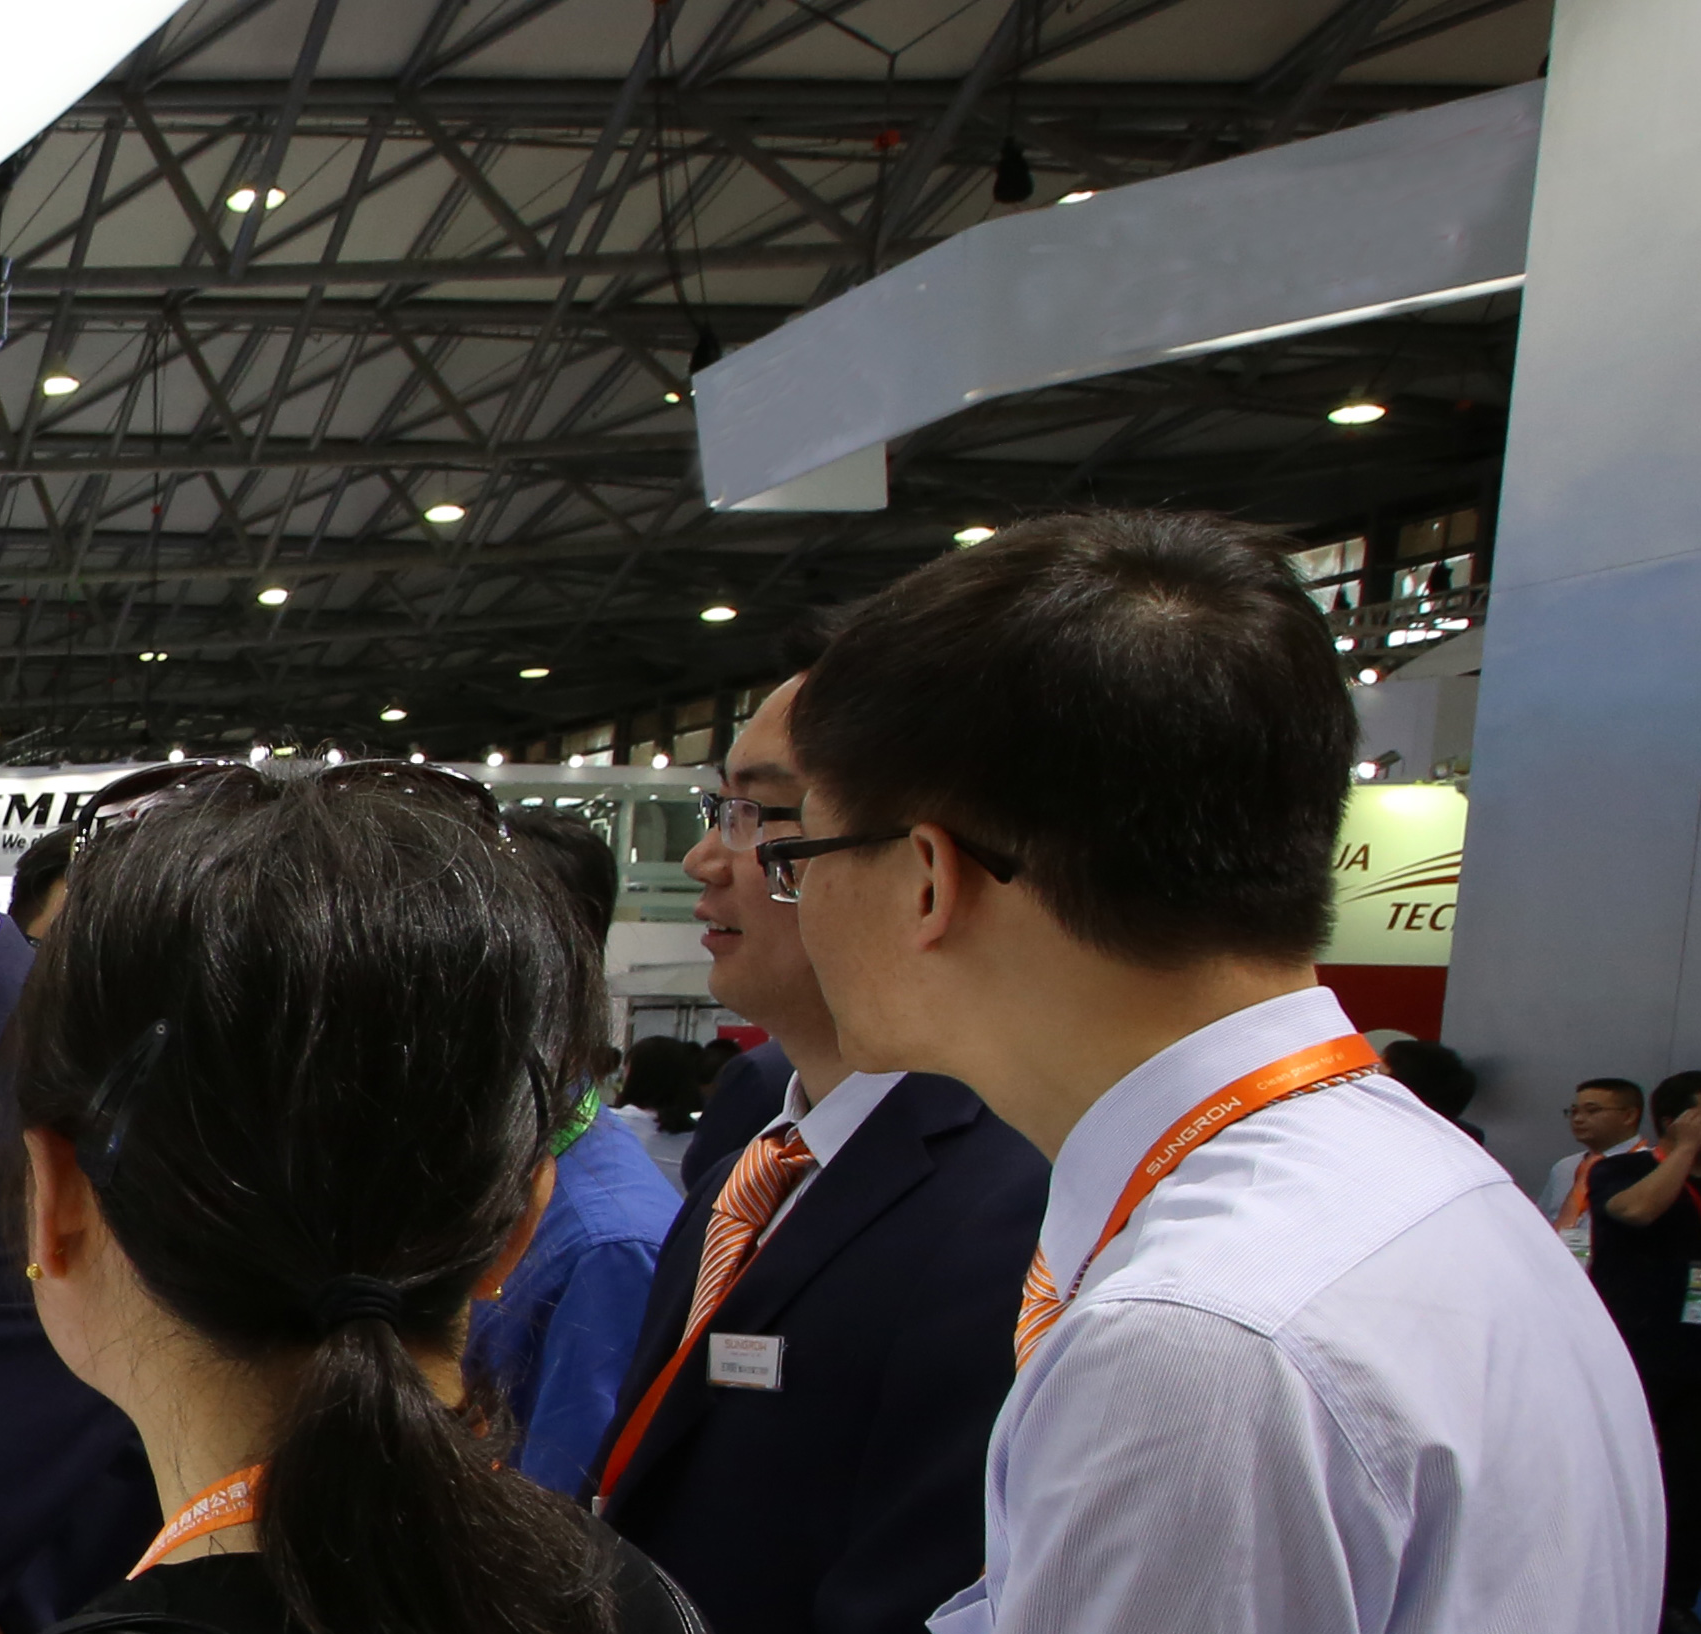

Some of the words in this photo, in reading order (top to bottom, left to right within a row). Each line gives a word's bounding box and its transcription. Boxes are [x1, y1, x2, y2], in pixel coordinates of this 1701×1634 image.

[2, 833, 26, 850] We
[1386, 903, 1456, 931] TEC
[1256, 1070, 1291, 1091] Clean
[1290, 1060, 1320, 1078] power
[1146, 1096, 1242, 1176] SUNGROW
